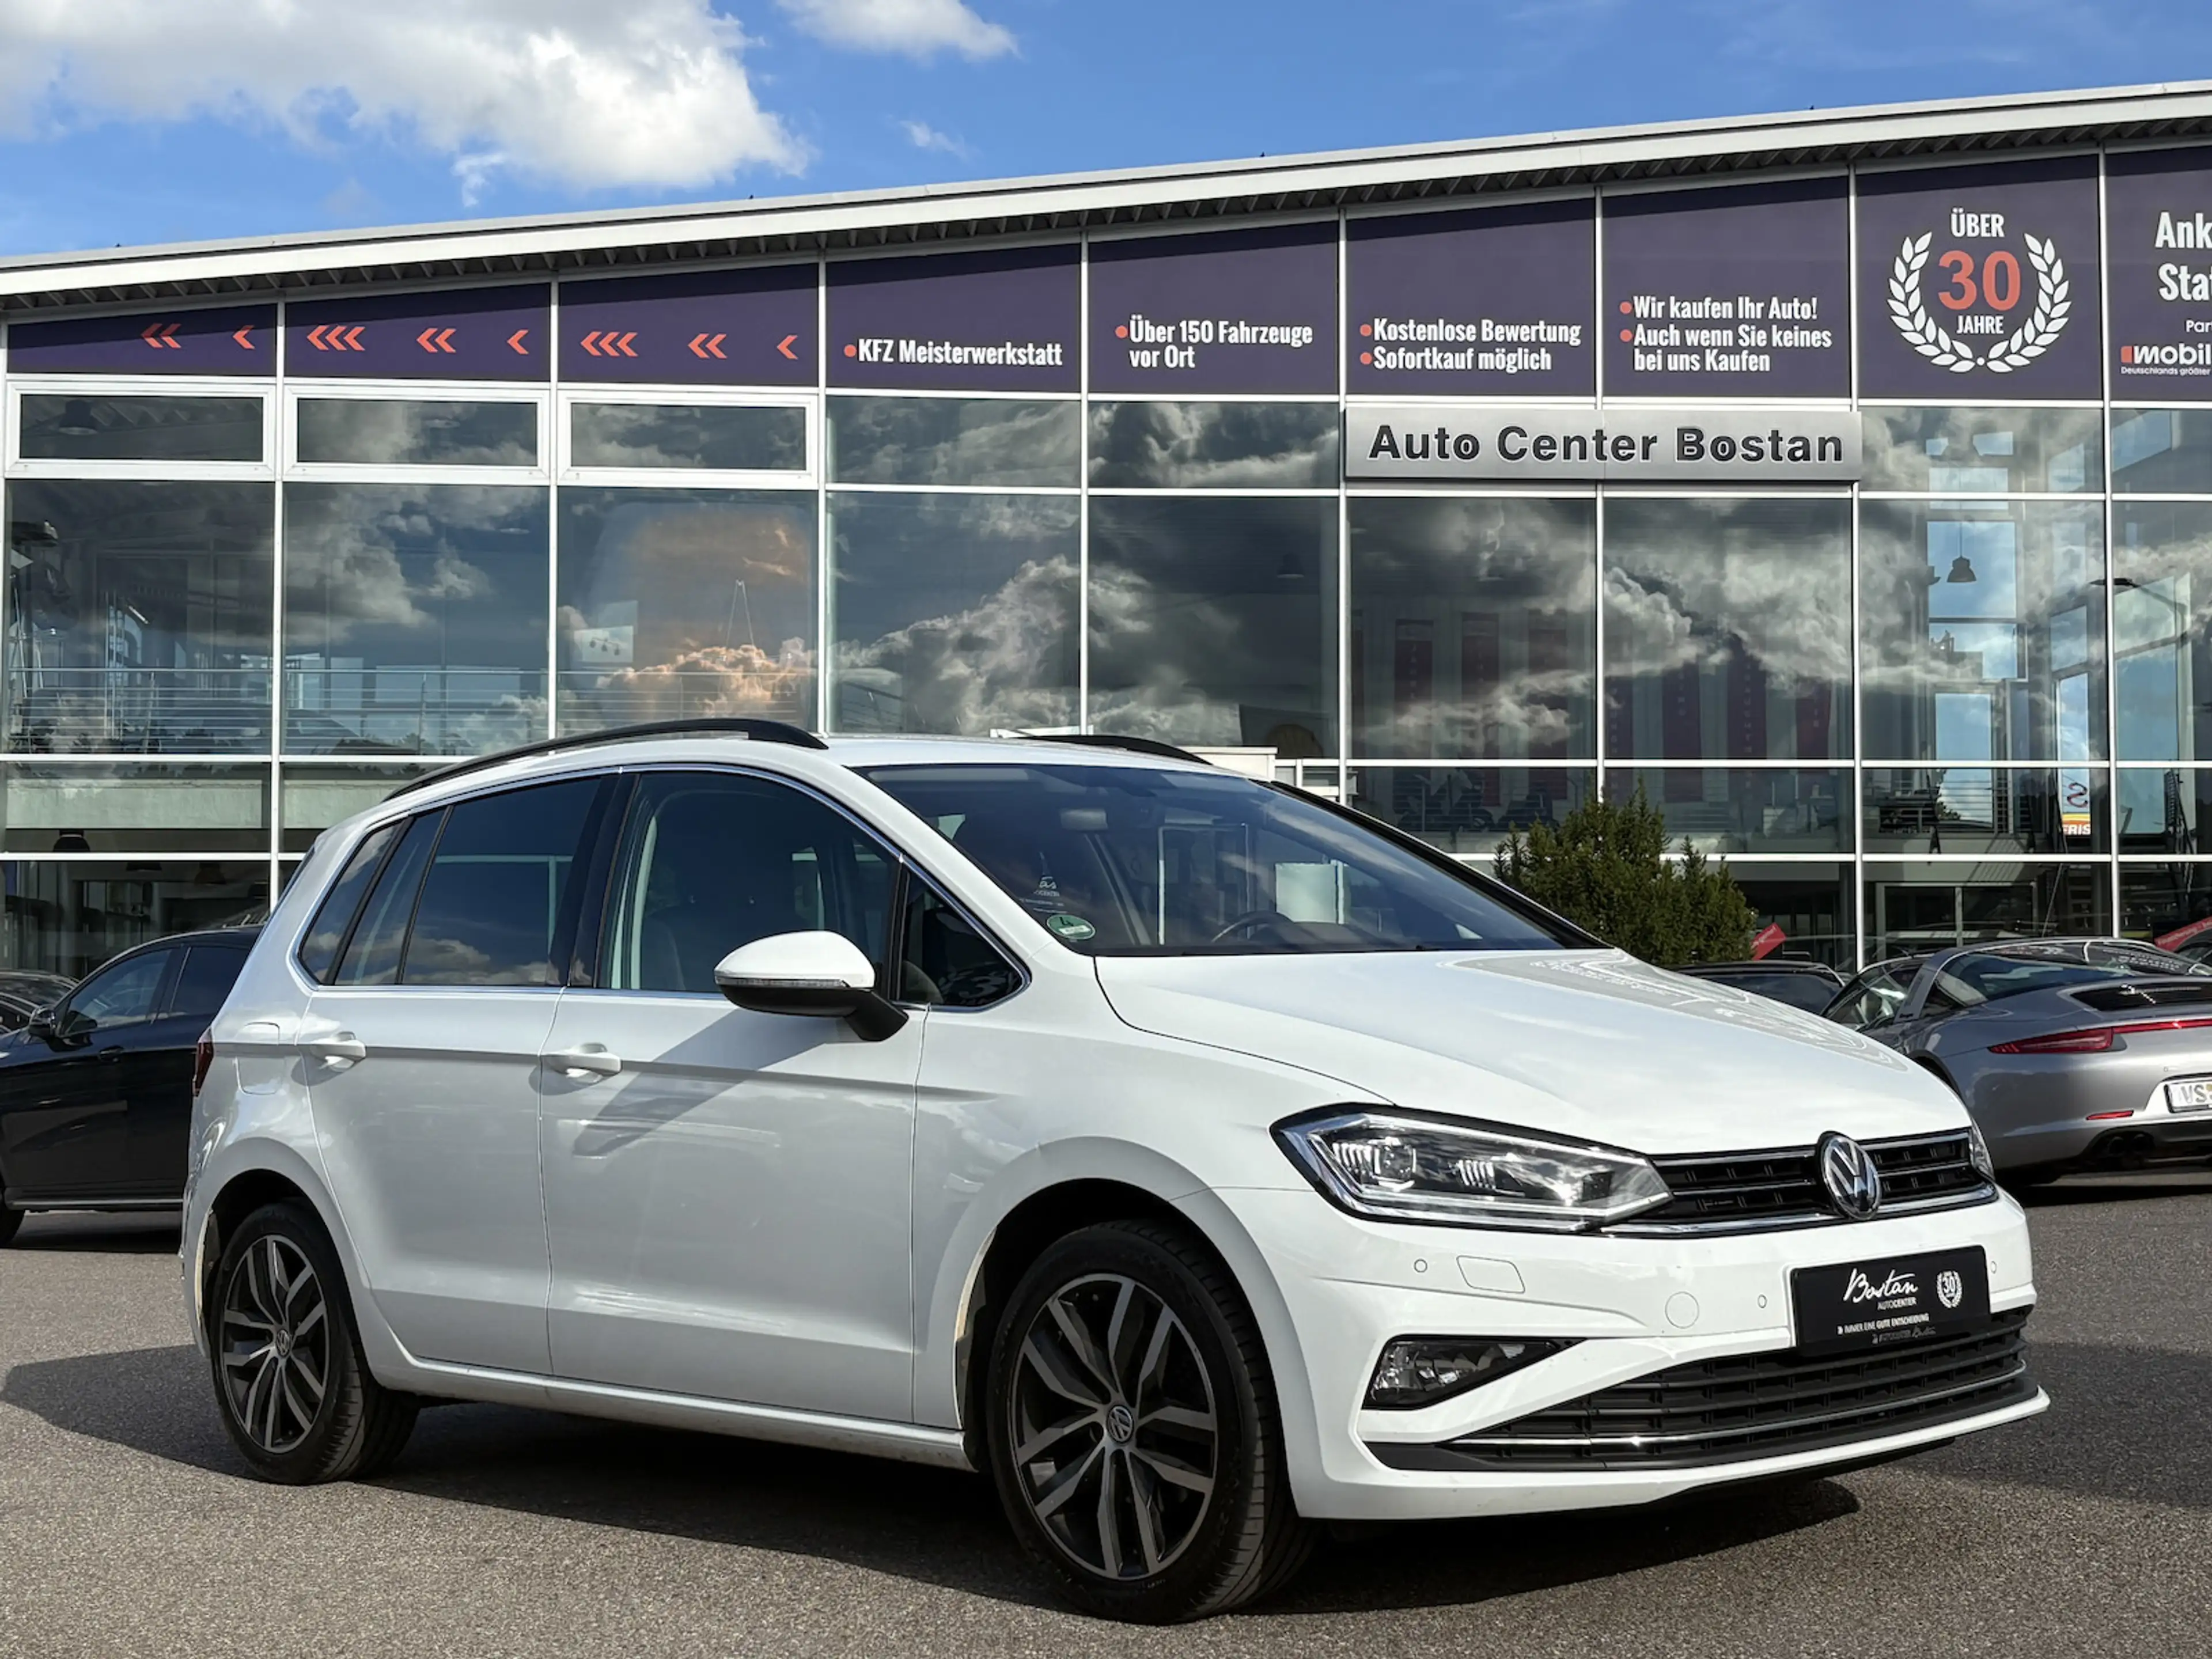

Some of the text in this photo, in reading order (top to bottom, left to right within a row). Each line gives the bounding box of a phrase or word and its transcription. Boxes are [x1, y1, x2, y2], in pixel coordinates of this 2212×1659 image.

[1950, 207, 2005, 237] ÜBER
[2155, 211, 2212, 248] Ank
[1938, 250, 2021, 311] 30
[1634, 296, 1817, 320] Wir kaufen Ihr Auto!
[1130, 315, 1313, 348] Über 150 Fahrzeuge
[1374, 318, 1582, 346] Kostenlose Bewertung
[1634, 324, 1832, 347] Auch wenn Sie keines
[1957, 316, 2004, 335] JAHRE
[2186, 320, 2212, 333] Par
[858, 339, 1063, 366] KFZ Meisterwerkstatt
[1130, 345, 1195, 368] vor Ort
[1374, 346, 1552, 373] Sofortkauf möglich
[1634, 349, 1770, 372] bei uns Kaufen
[2133, 343, 2211, 365] mobil
[2120, 366, 2178, 374] Deutschlands
[1368, 424, 1843, 463] Auto Center Bostan
[1843, 1268, 1919, 1303] Bostan
